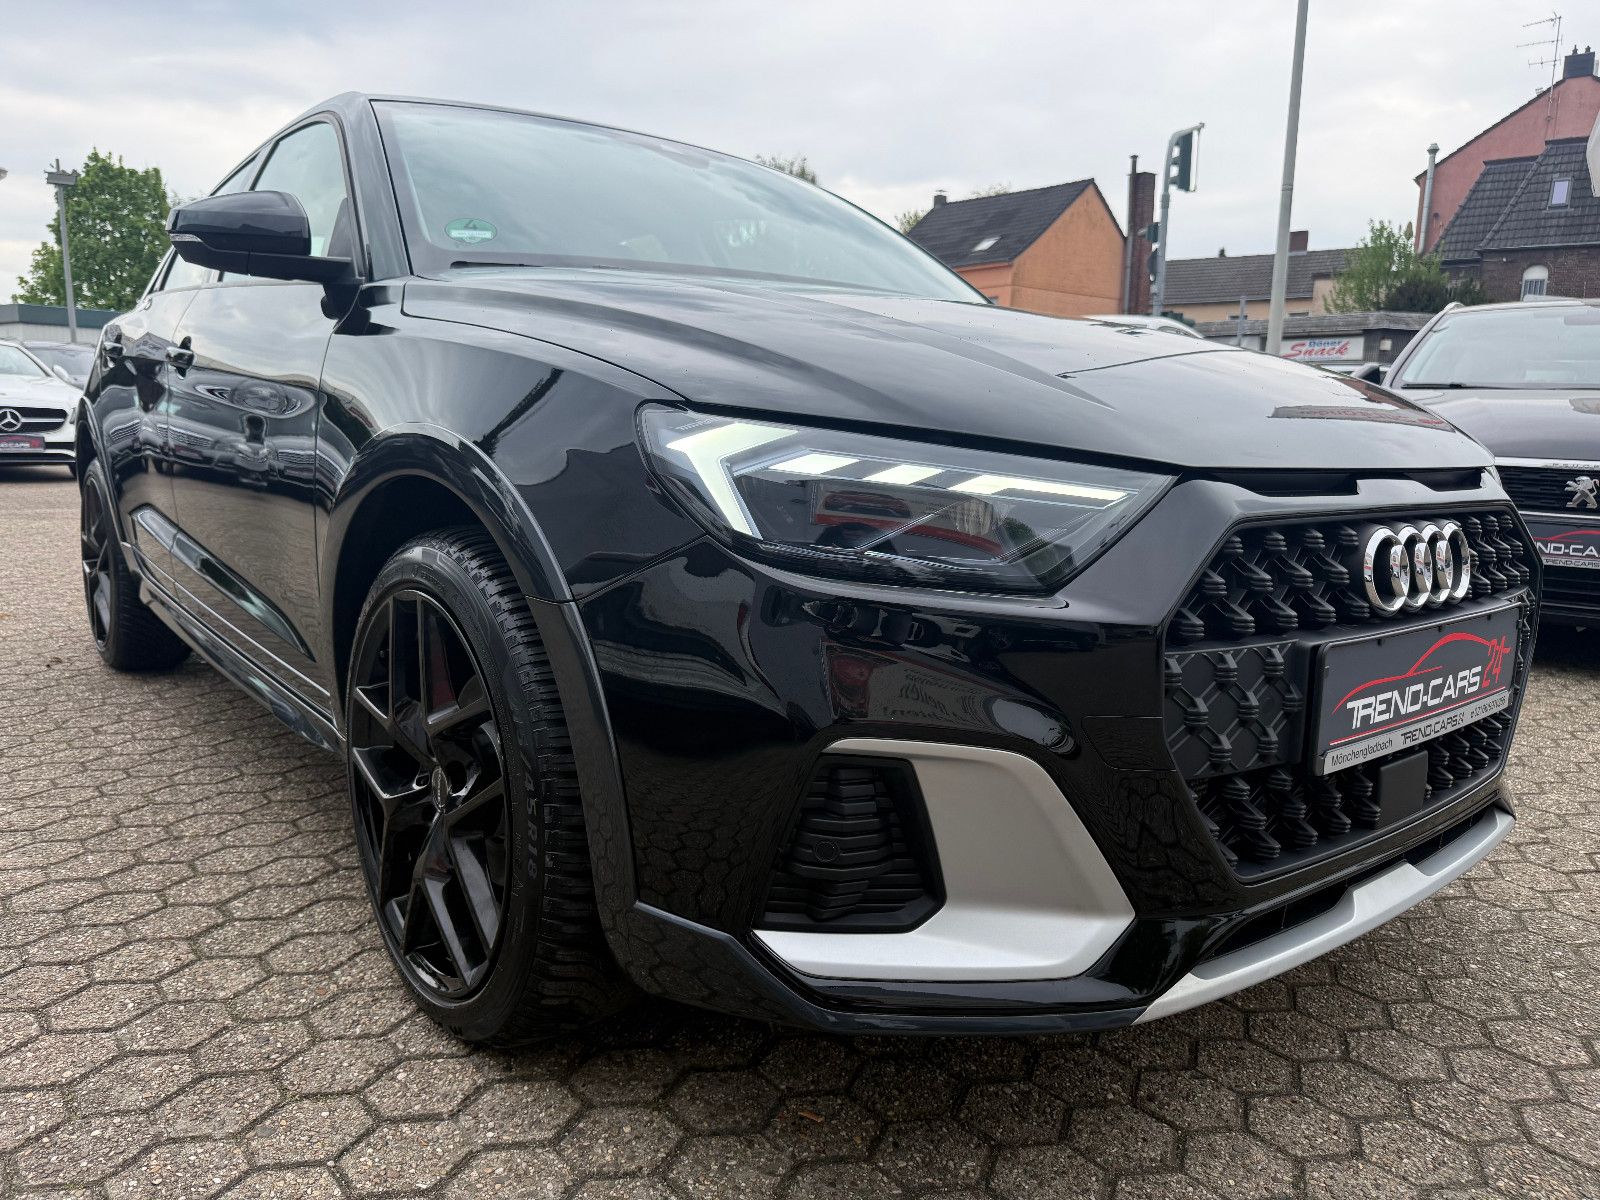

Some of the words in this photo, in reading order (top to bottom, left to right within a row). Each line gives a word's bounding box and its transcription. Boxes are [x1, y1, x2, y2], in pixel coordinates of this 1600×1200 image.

[1282, 340, 1350, 359] Snack
[1534, 541, 1600, 558] ND-CA
[1345, 665, 1482, 730] TREND-CARS
[1481, 635, 1511, 689] 24
[1331, 738, 1393, 767] Mönchengladbach
